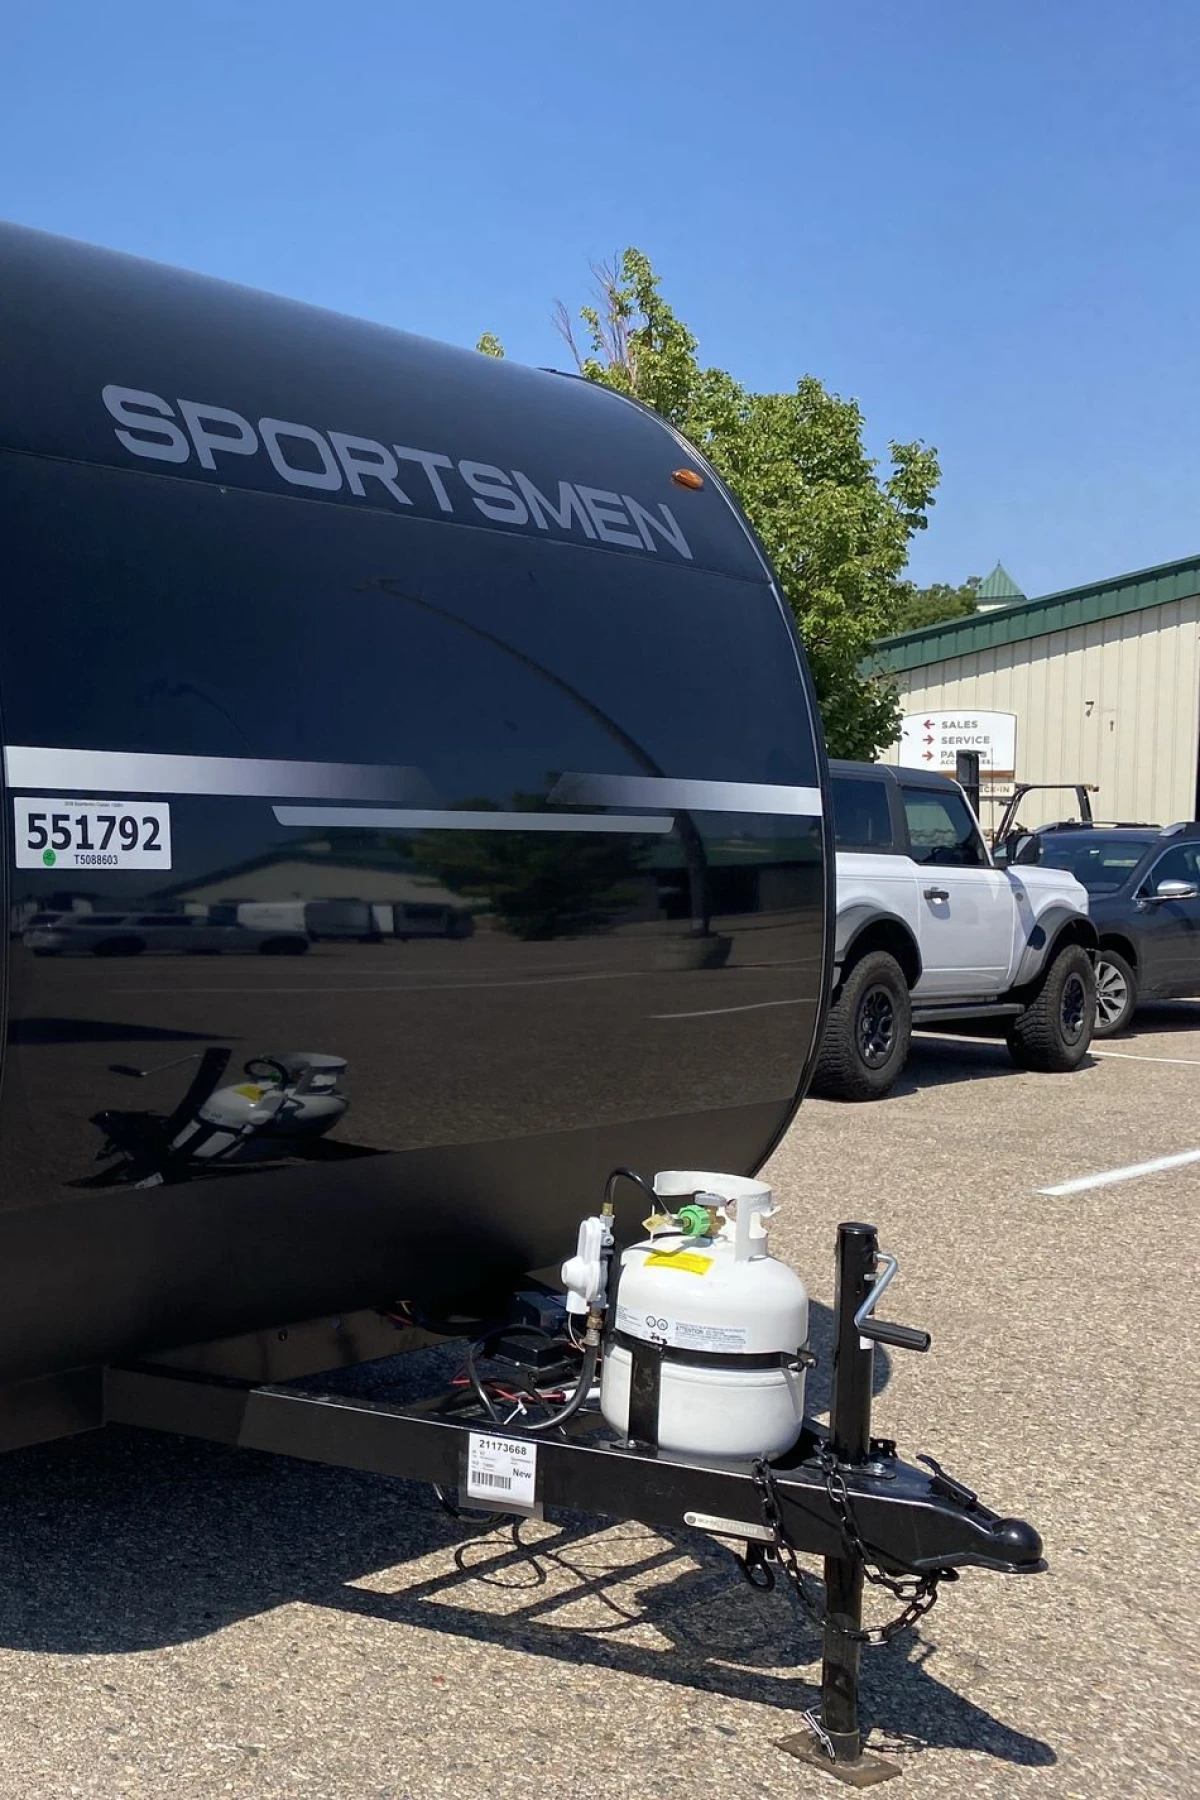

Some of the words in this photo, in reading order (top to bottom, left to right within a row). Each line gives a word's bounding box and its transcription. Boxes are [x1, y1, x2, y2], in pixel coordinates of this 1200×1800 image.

[102, 384, 693, 559] SPORTSMEN
[941, 720, 979, 729] SALES
[941, 736, 990, 745] SERVICE
[27, 813, 162, 851] 551792
[74, 854, 118, 865] T5088603
[479, 1439, 527, 1456] 21173668
[512, 1468, 532, 1479] New
